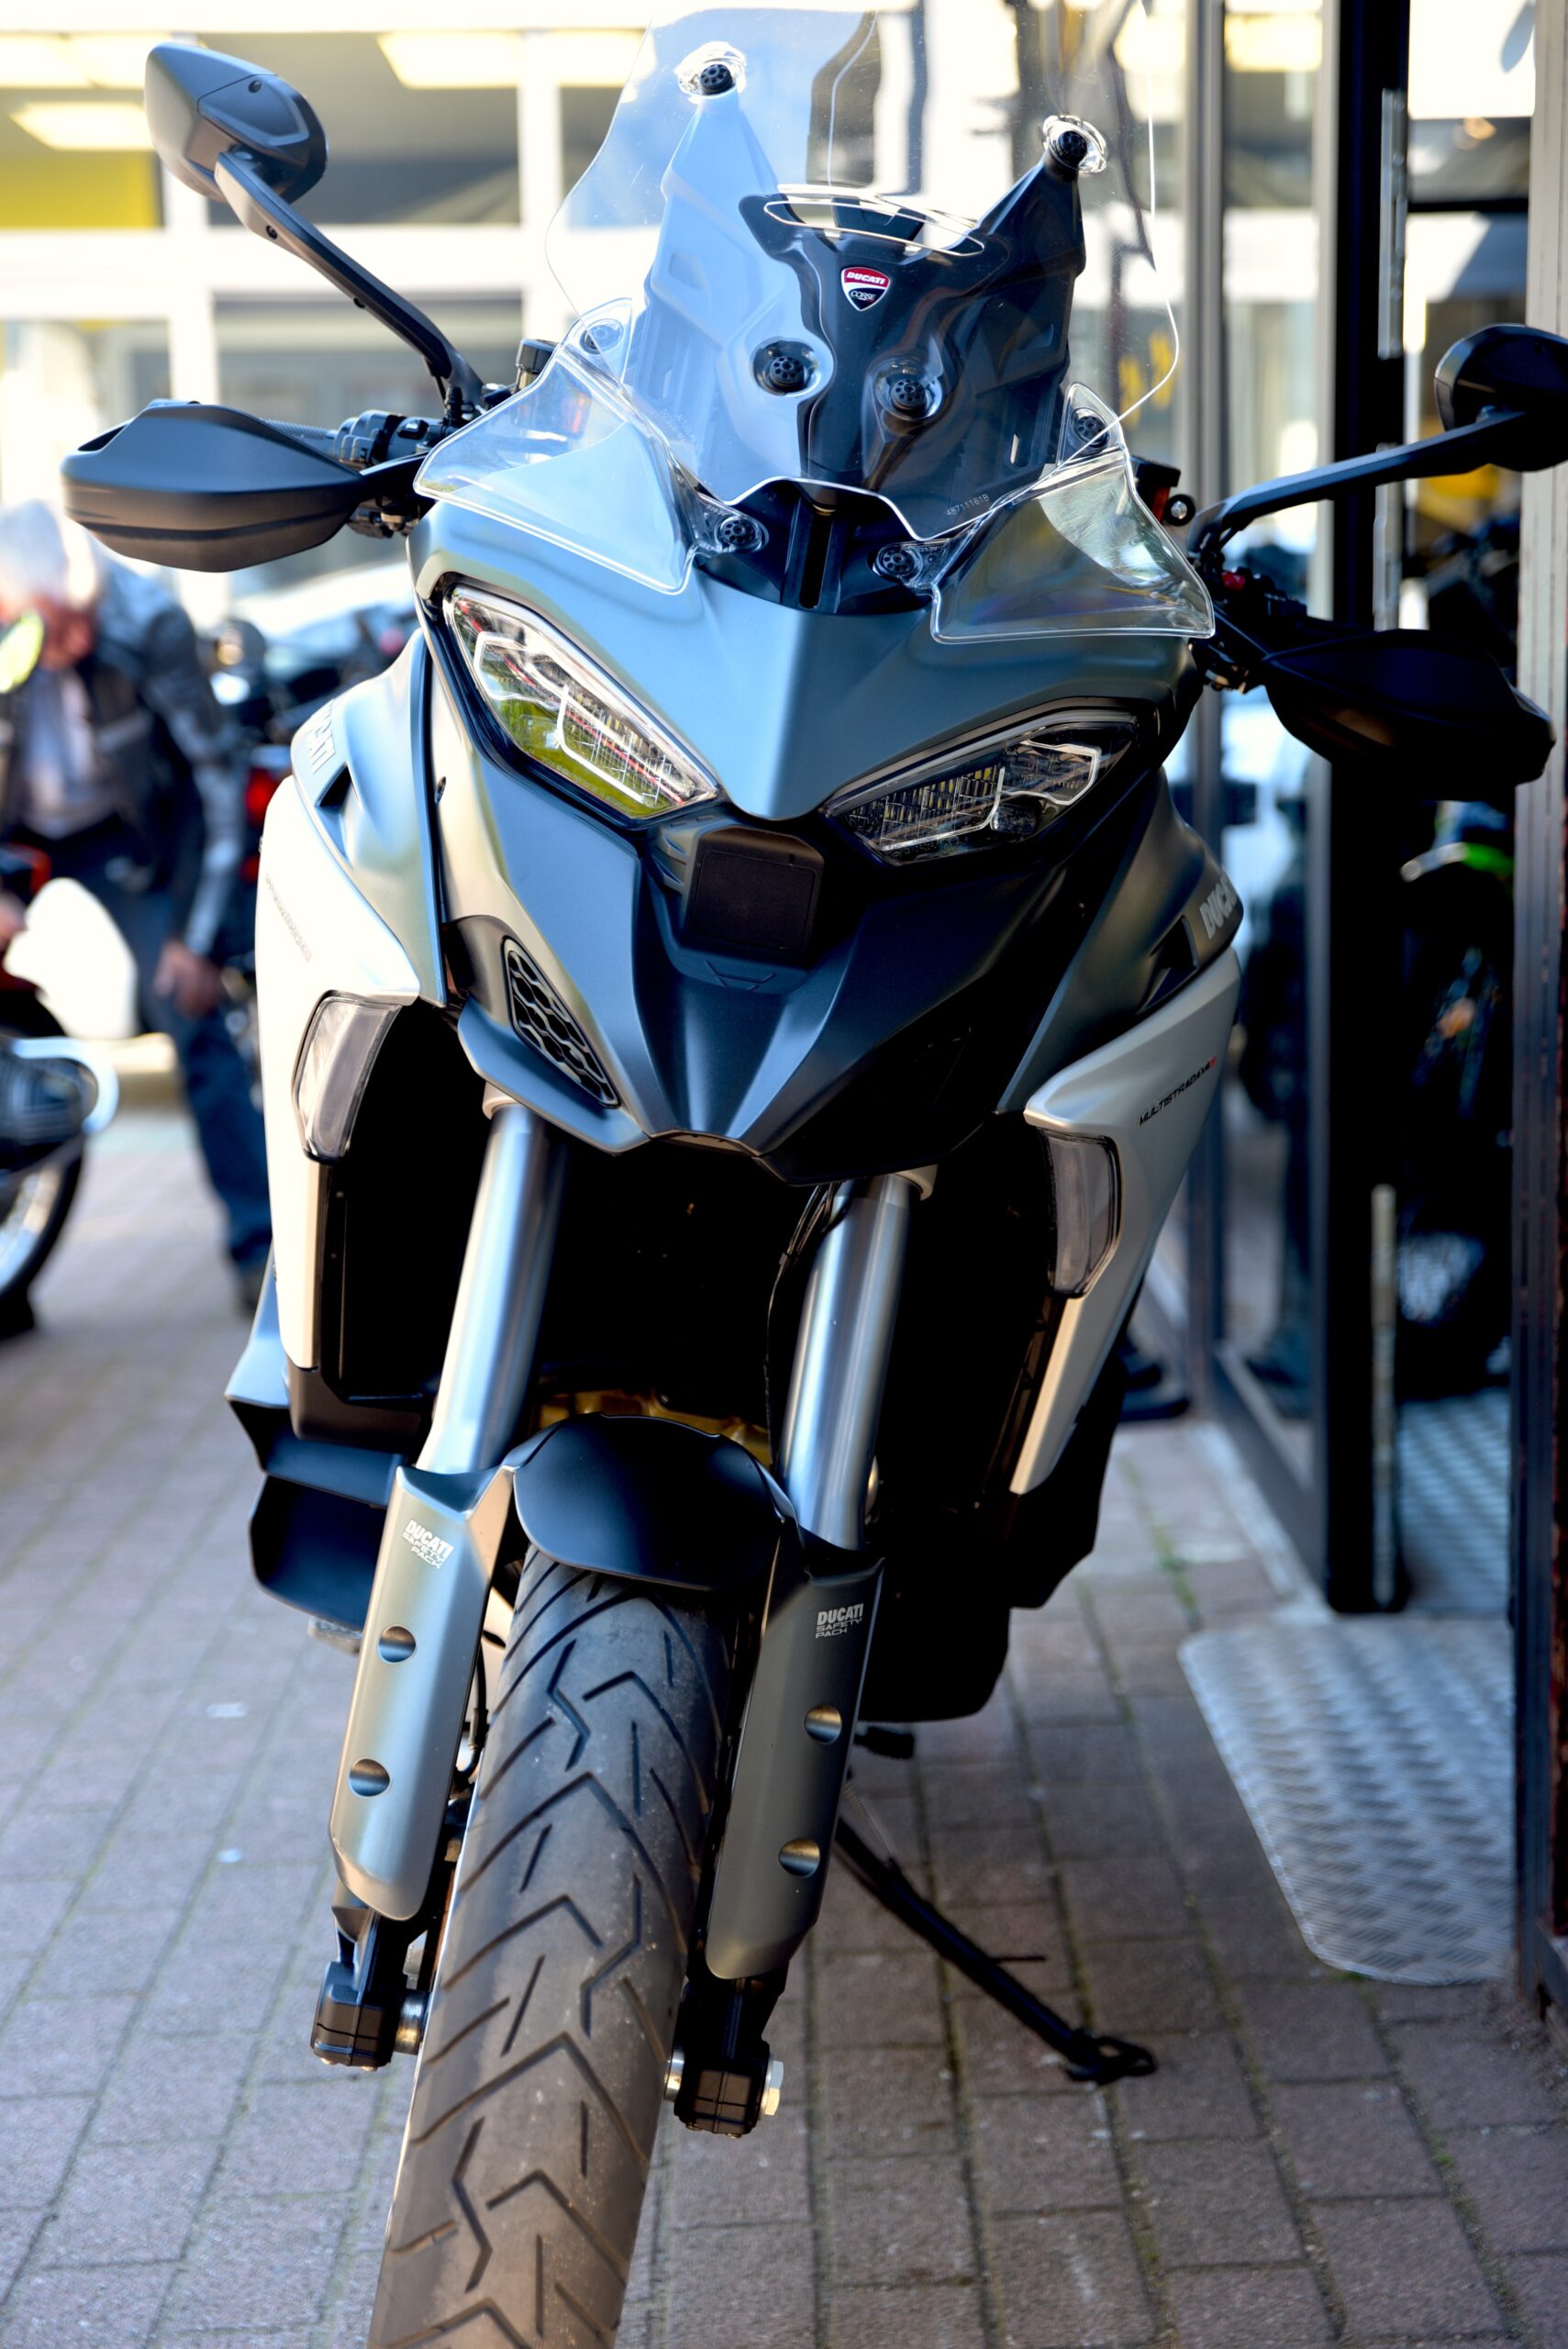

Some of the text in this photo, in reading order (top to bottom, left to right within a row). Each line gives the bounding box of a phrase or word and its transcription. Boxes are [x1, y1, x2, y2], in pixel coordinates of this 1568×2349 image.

[847, 272, 886, 284] DUCATI
[851, 290, 876, 300] CORSE
[1199, 874, 1236, 940] DUCA
[406, 1520, 454, 1557] DUCATI
[411, 1545, 441, 1569] PACK
[817, 1603, 864, 1626] DUCATI
[815, 1628, 848, 1639] PACK
[816, 1617, 862, 1632] SAFETY
